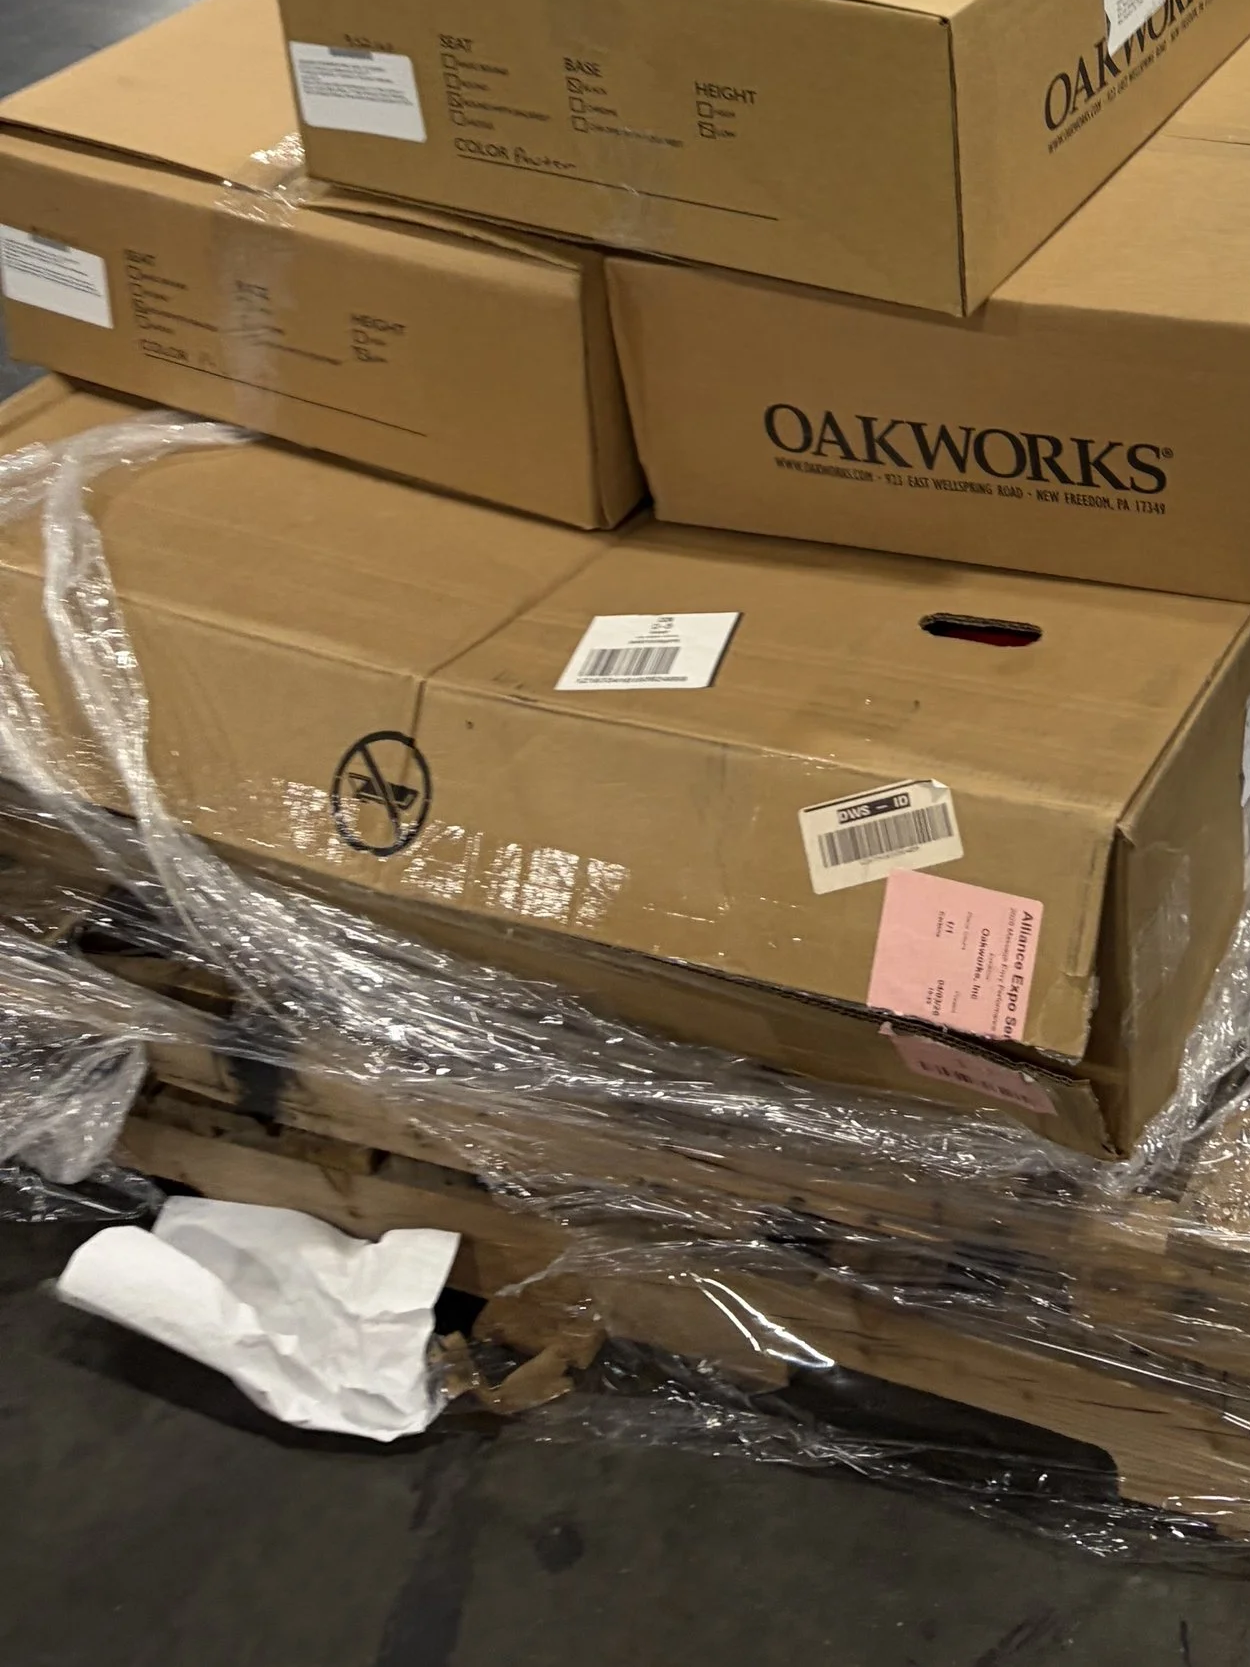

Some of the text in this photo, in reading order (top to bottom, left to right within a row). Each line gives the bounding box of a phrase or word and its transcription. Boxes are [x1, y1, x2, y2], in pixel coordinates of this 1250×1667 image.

[438, 33, 473, 52] SEAT
[562, 56, 603, 78] BASE
[694, 81, 757, 105] HEIGHT
[454, 137, 509, 160] COLOR
[884, 473, 903, 487] 923
[908, 475, 931, 489] EAST
[931, 477, 992, 495] WELLSPRING
[997, 484, 1024, 499] ROAD
[1036, 489, 1059, 503] NEW
[1116, 497, 1130, 511] PA
[1134, 499, 1166, 515] 17349
[839, 804, 871, 822] DWS
[893, 795, 909, 809] ID
[1014, 910, 1034, 970] Alliance
[973, 928, 990, 982] Oakworks,
[970, 984, 981, 1000] Inc
[1007, 974, 1024, 1012] Expo
